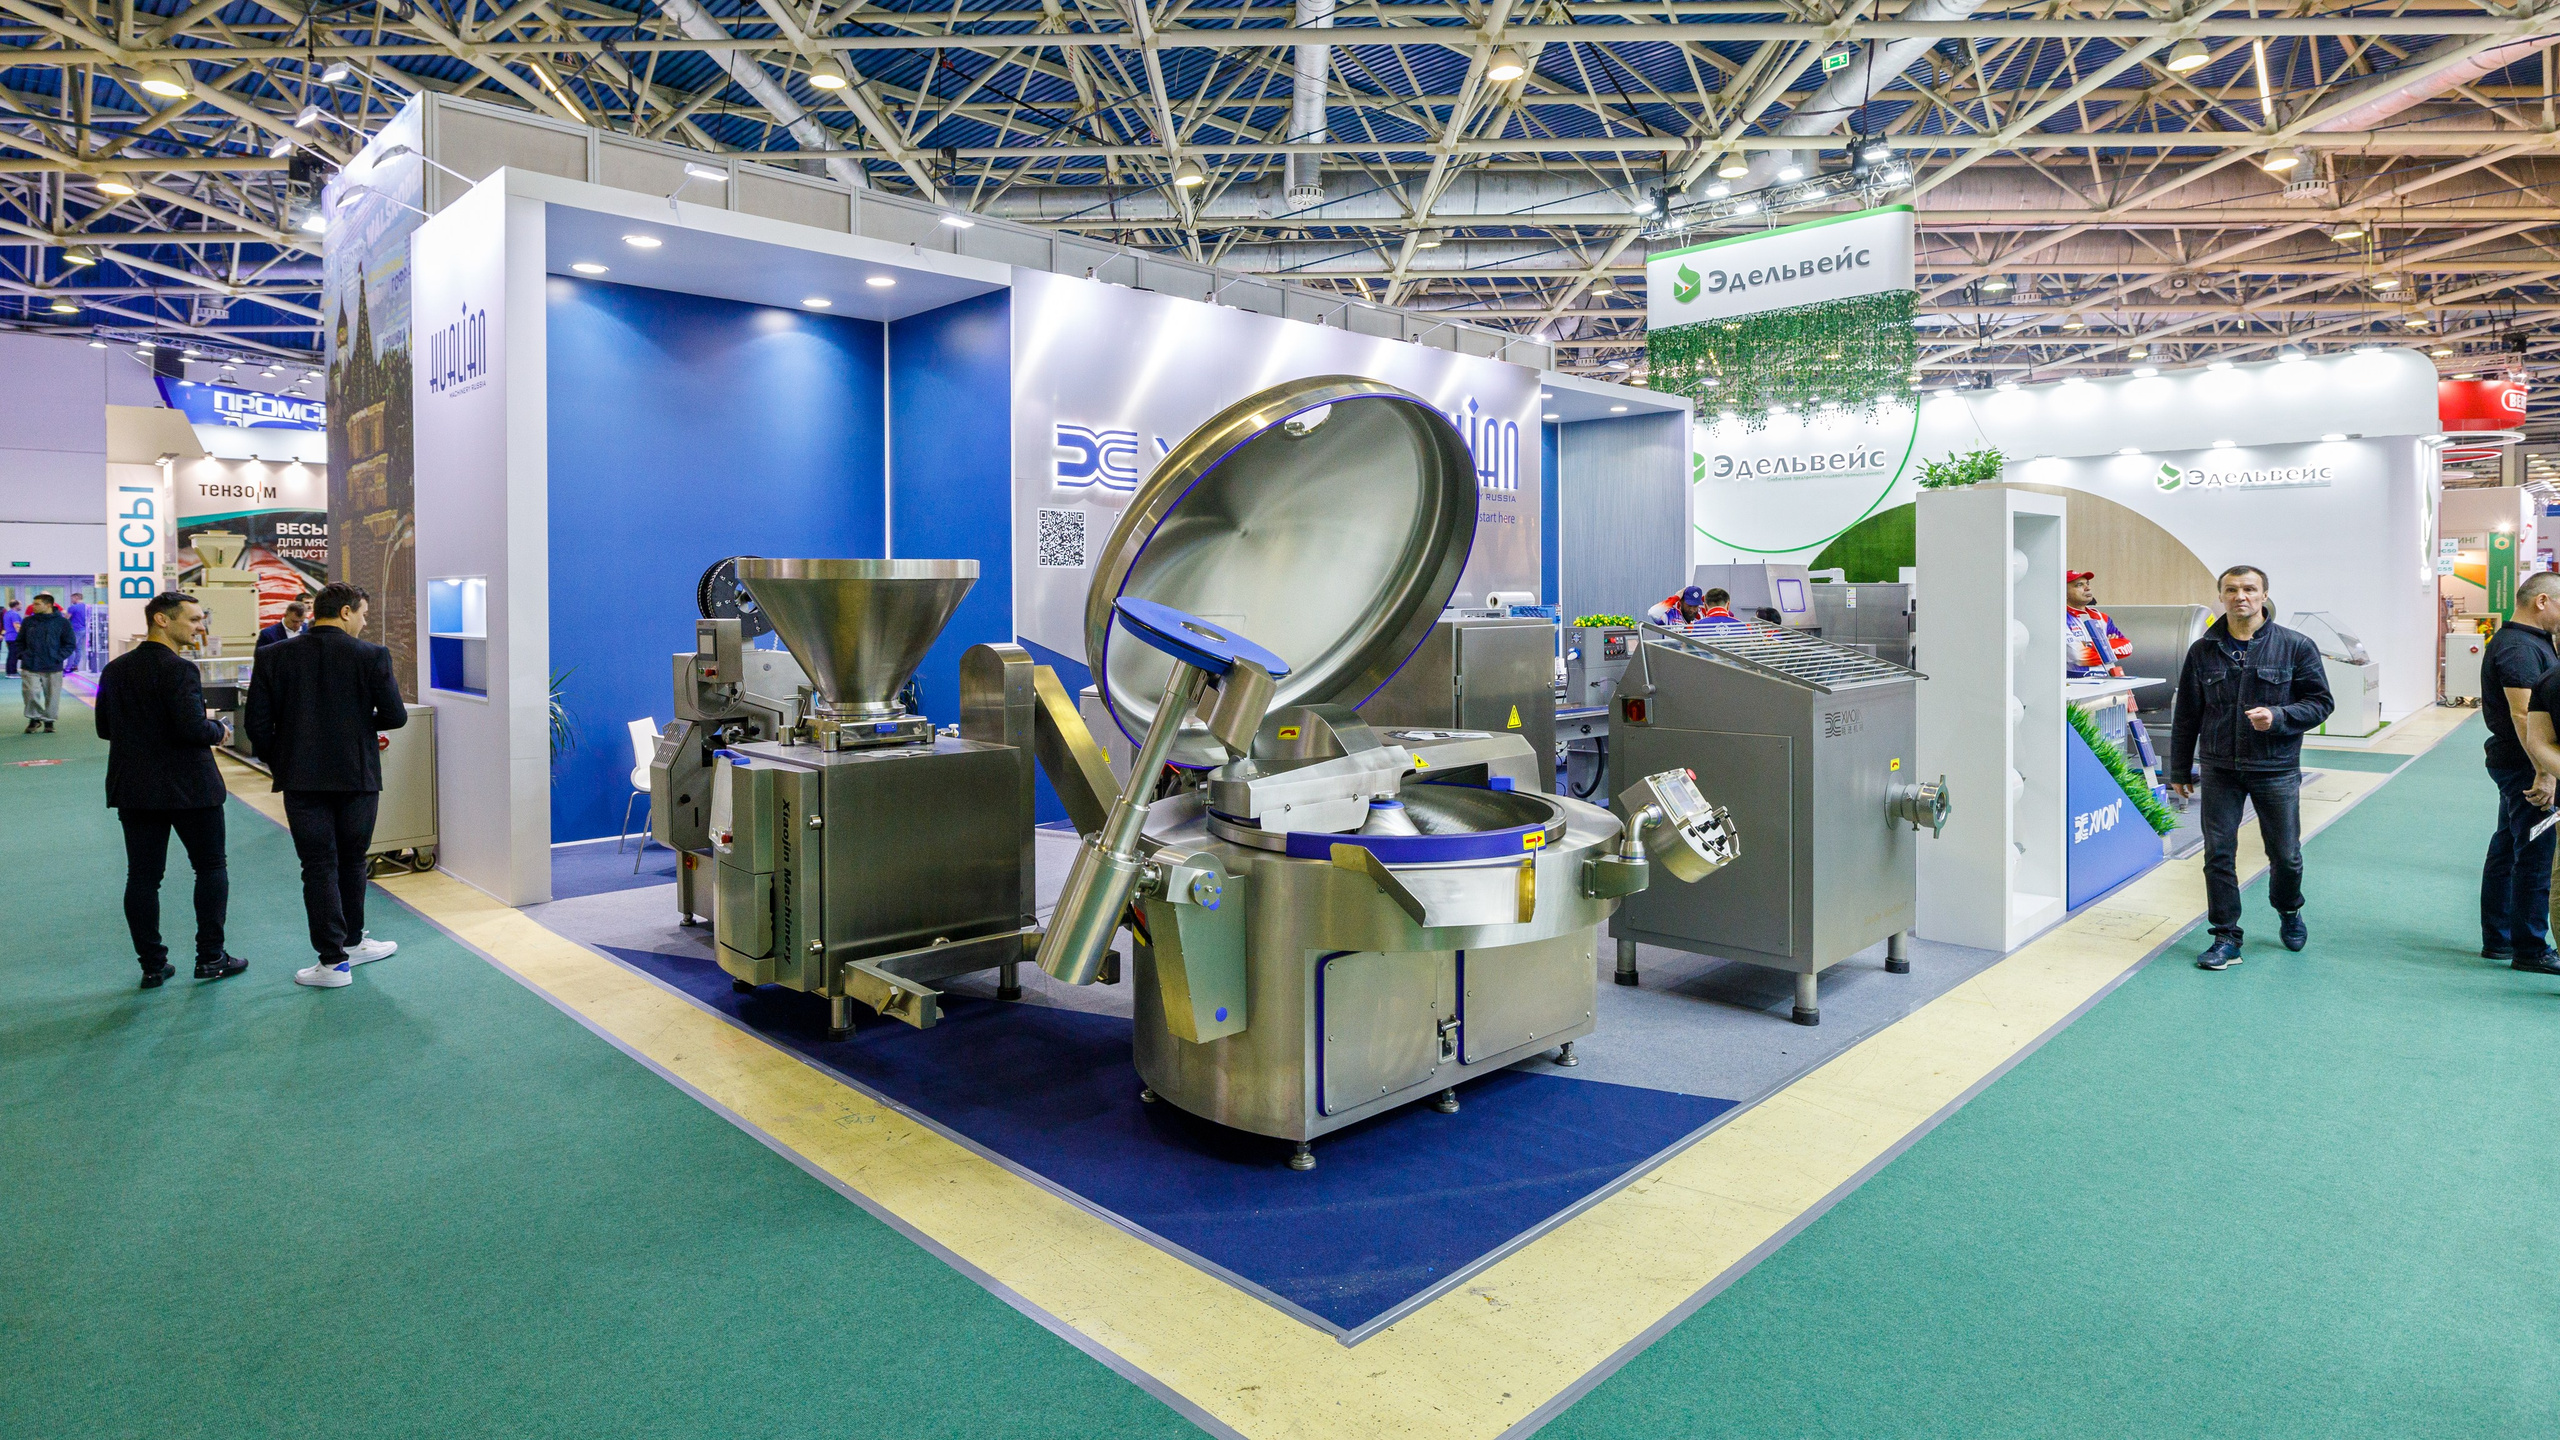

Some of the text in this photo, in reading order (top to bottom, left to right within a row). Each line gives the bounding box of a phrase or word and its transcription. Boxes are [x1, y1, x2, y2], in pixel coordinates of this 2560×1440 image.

[1708, 246, 1870, 292] Эдельвейс
[1714, 445, 1885, 479] Эдельвейс
[2188, 464, 2332, 487] Эдельвейс
[1486, 493, 1517, 503] RUSSIA
[276, 523, 328, 536] ВЕСЫ
[1498, 512, 1516, 524] here
[119, 486, 155, 599] ВЕСЫ
[277, 537, 302, 548] ДЛЯ
[782, 798, 793, 966] Xiaojin Machinery
